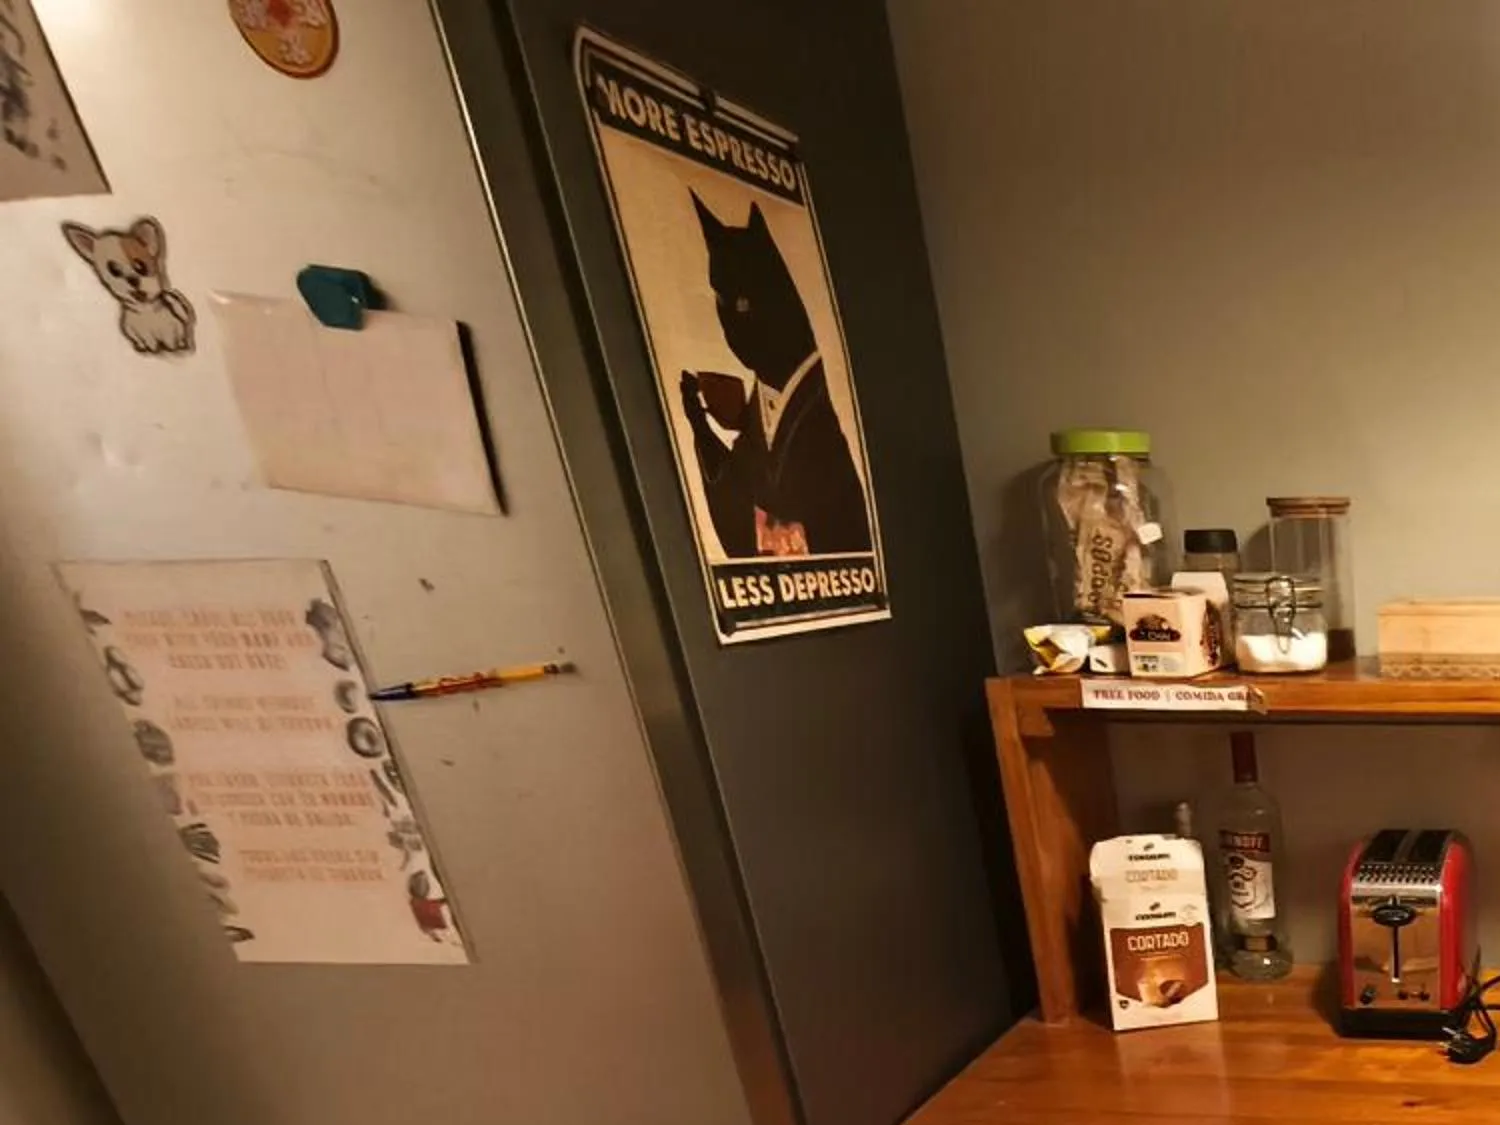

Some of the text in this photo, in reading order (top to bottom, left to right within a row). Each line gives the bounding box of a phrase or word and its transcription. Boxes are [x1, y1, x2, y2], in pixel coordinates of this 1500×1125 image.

[597, 74, 796, 191] MORE ESPRESSO
[718, 567, 875, 609] LESS DEPRESSO
[1094, 690, 1125, 701] FREE
[1128, 690, 1160, 701] FOOD
[1175, 691, 1224, 702] COMIDA
[1127, 931, 1190, 952] CORTADO
